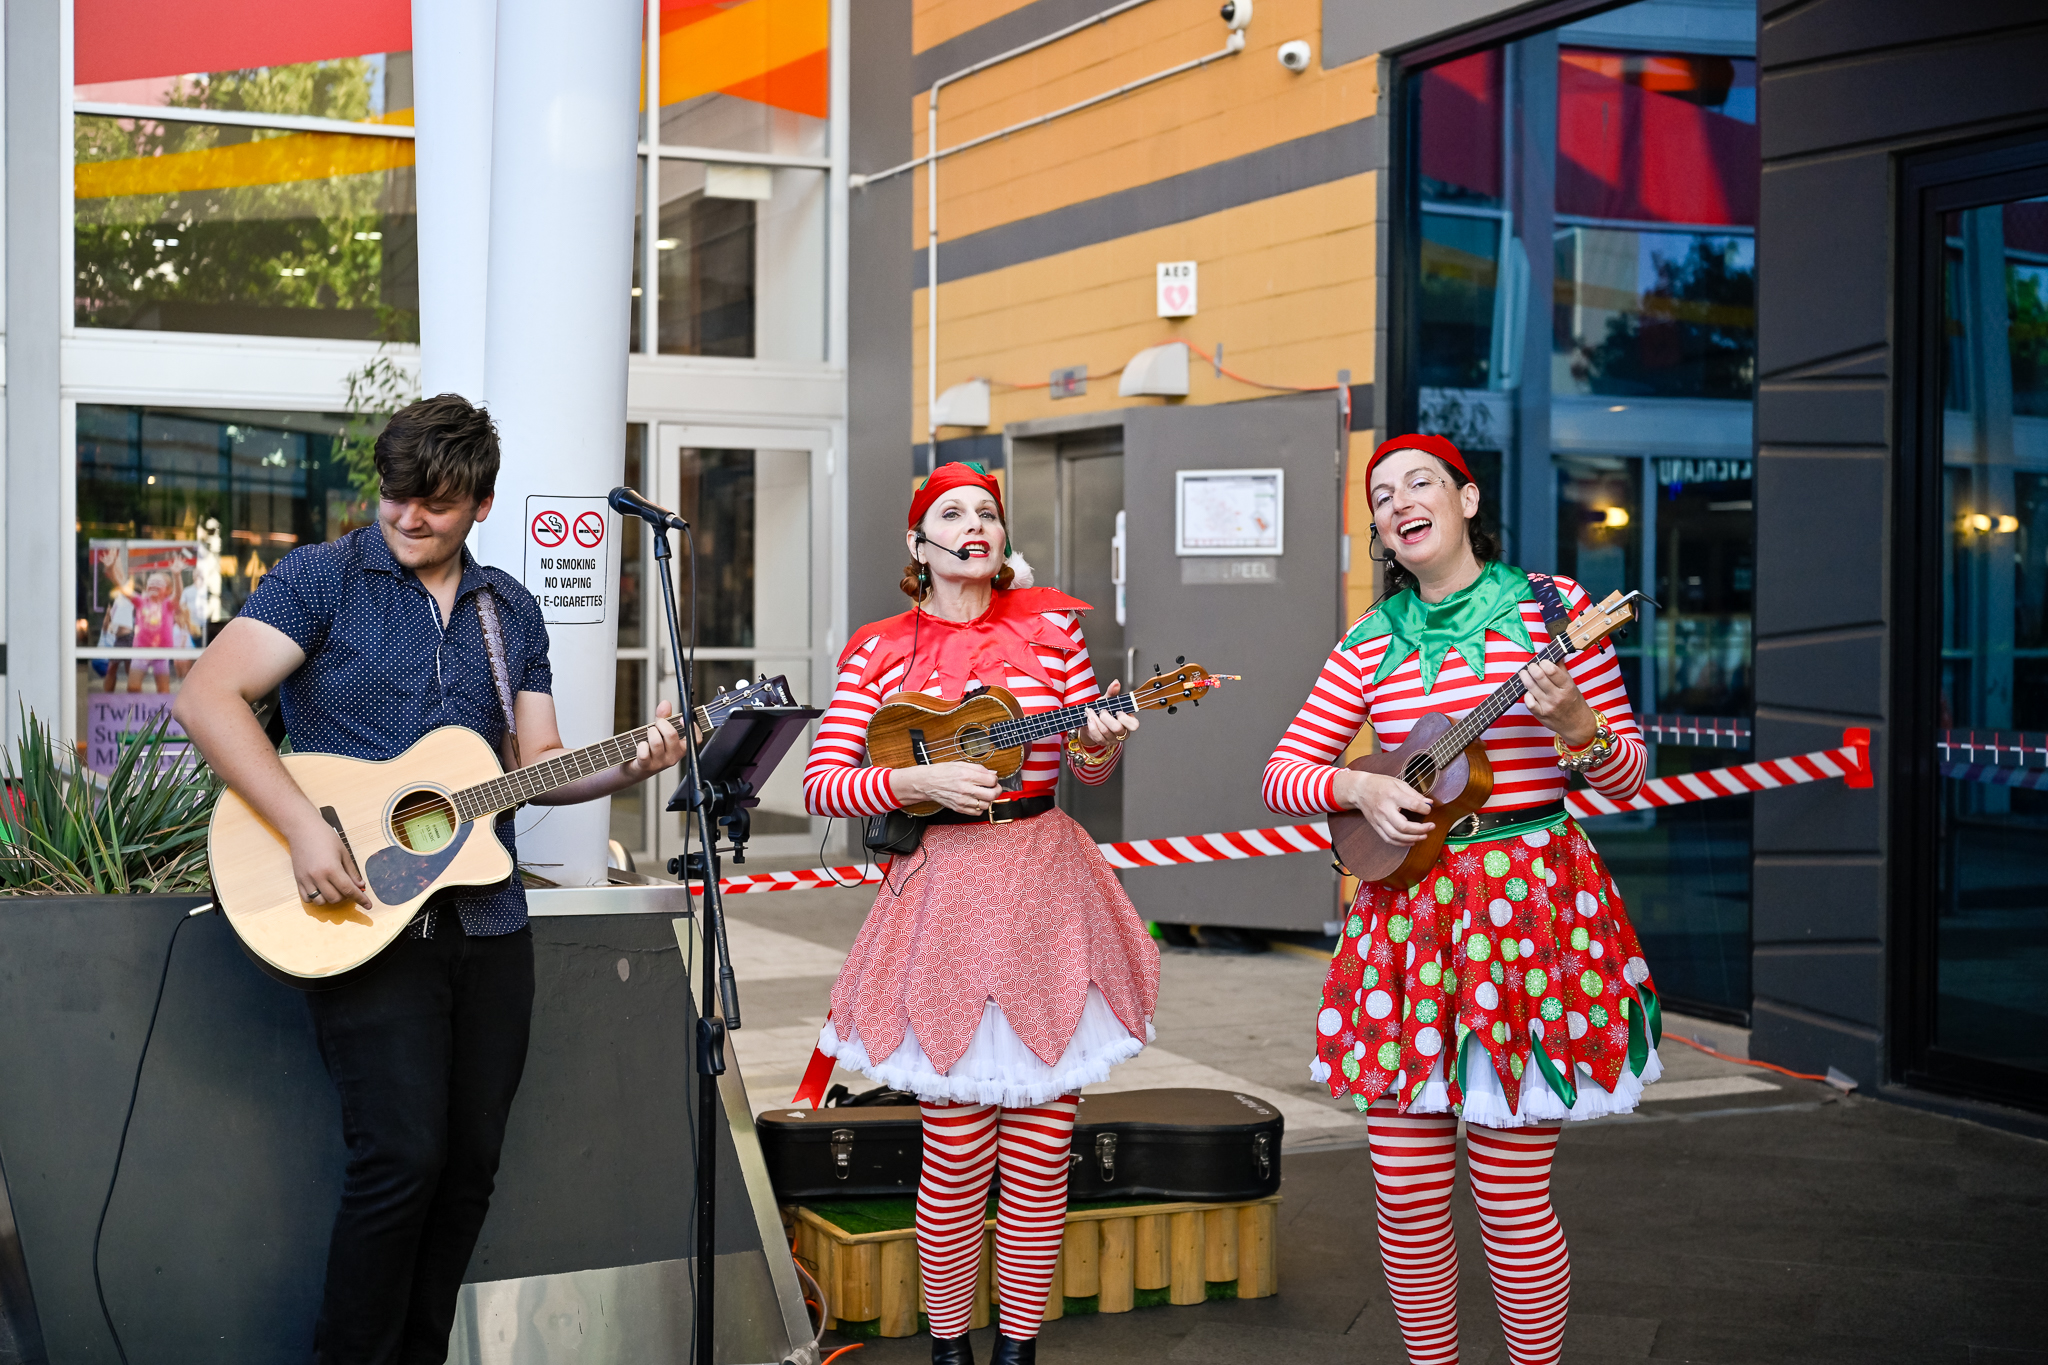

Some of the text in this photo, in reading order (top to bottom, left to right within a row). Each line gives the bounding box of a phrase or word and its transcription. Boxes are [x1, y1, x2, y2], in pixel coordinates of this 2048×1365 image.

[1163, 266, 1191, 278] AED
[541, 558, 596, 570] NO SMOKING
[545, 577, 592, 588] NO VAPING
[544, 595, 603, 607] E-CIGARETTES
